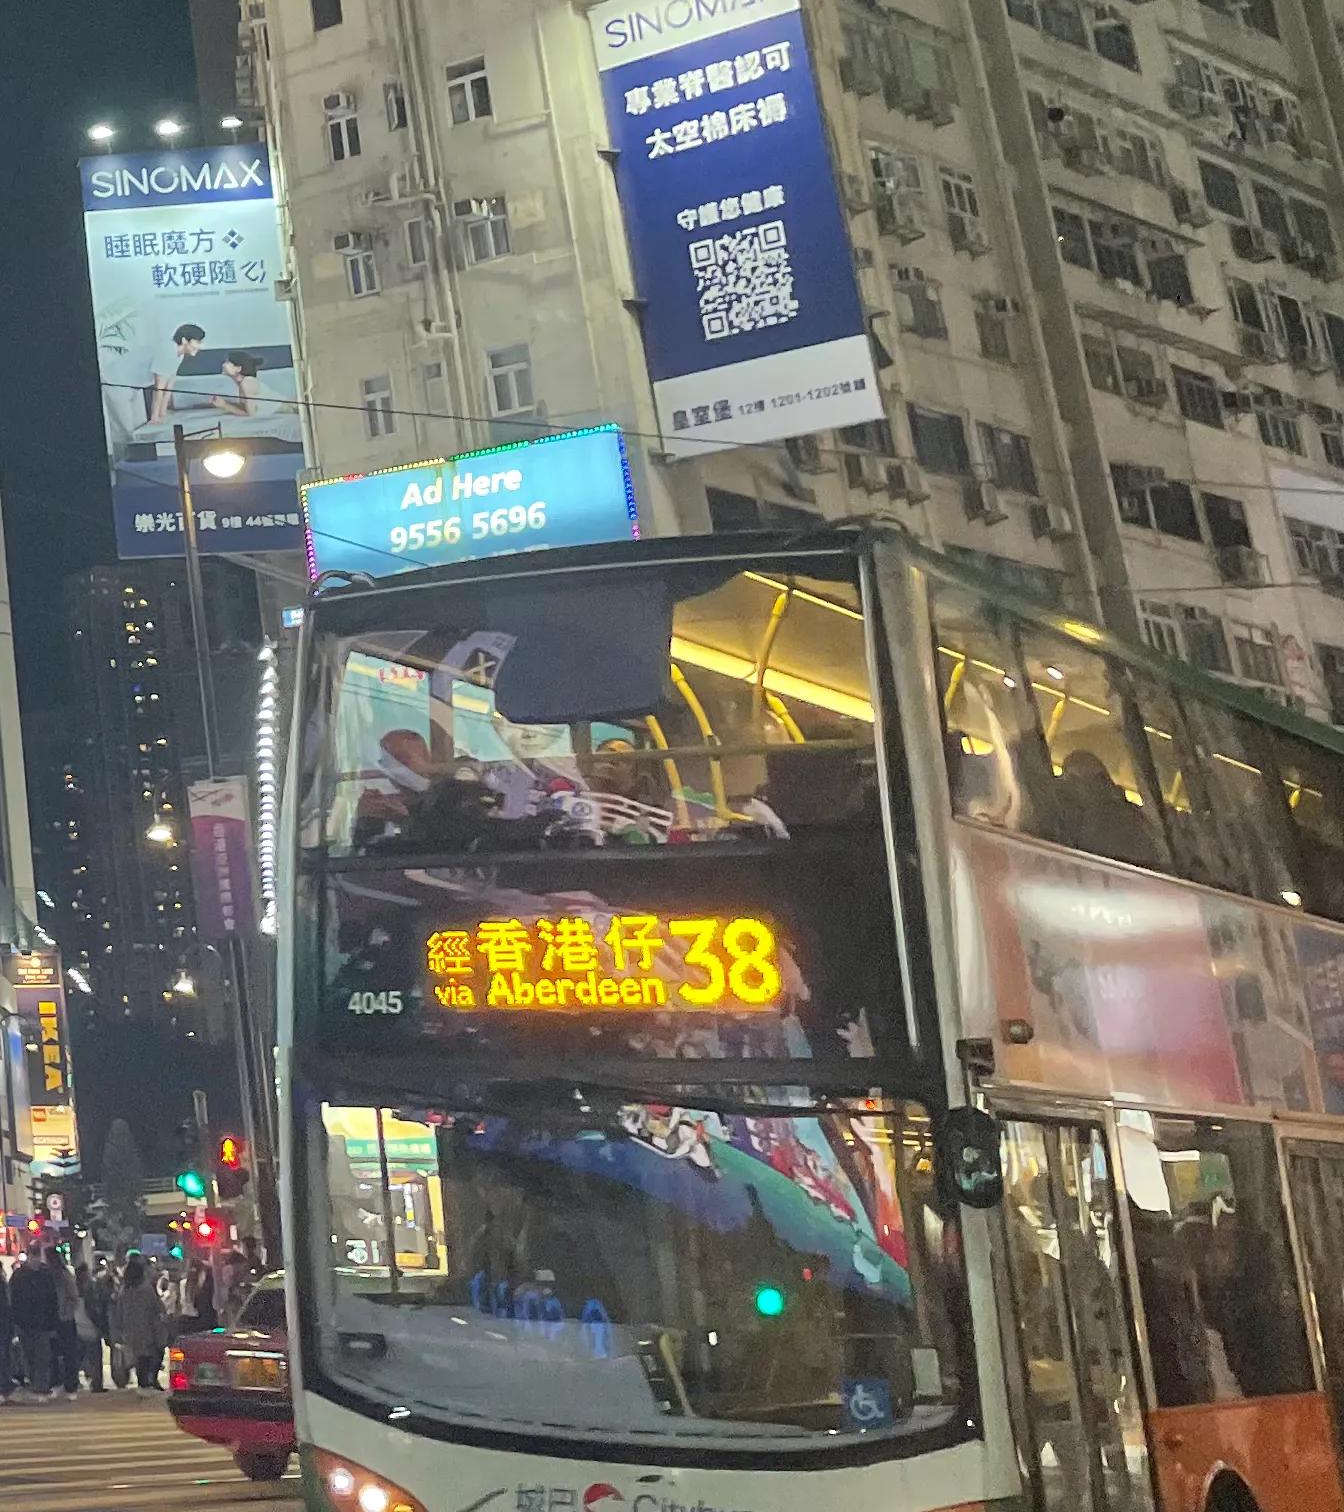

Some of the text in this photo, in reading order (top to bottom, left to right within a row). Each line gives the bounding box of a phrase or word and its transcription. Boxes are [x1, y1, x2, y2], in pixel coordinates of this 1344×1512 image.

[623, 40, 792, 117] 專業脊醫認可
[644, 92, 788, 161] 太空棉床褥
[91, 157, 265, 199] SINOMAX
[103, 227, 217, 260] 睡眠魔方
[400, 467, 523, 511] Ad Here
[390, 500, 547, 553] 9556 5696
[426, 914, 782, 1005] 經 香港仔 38
[347, 991, 404, 1015] 4045
[433, 974, 666, 1007] via Aberdeen
